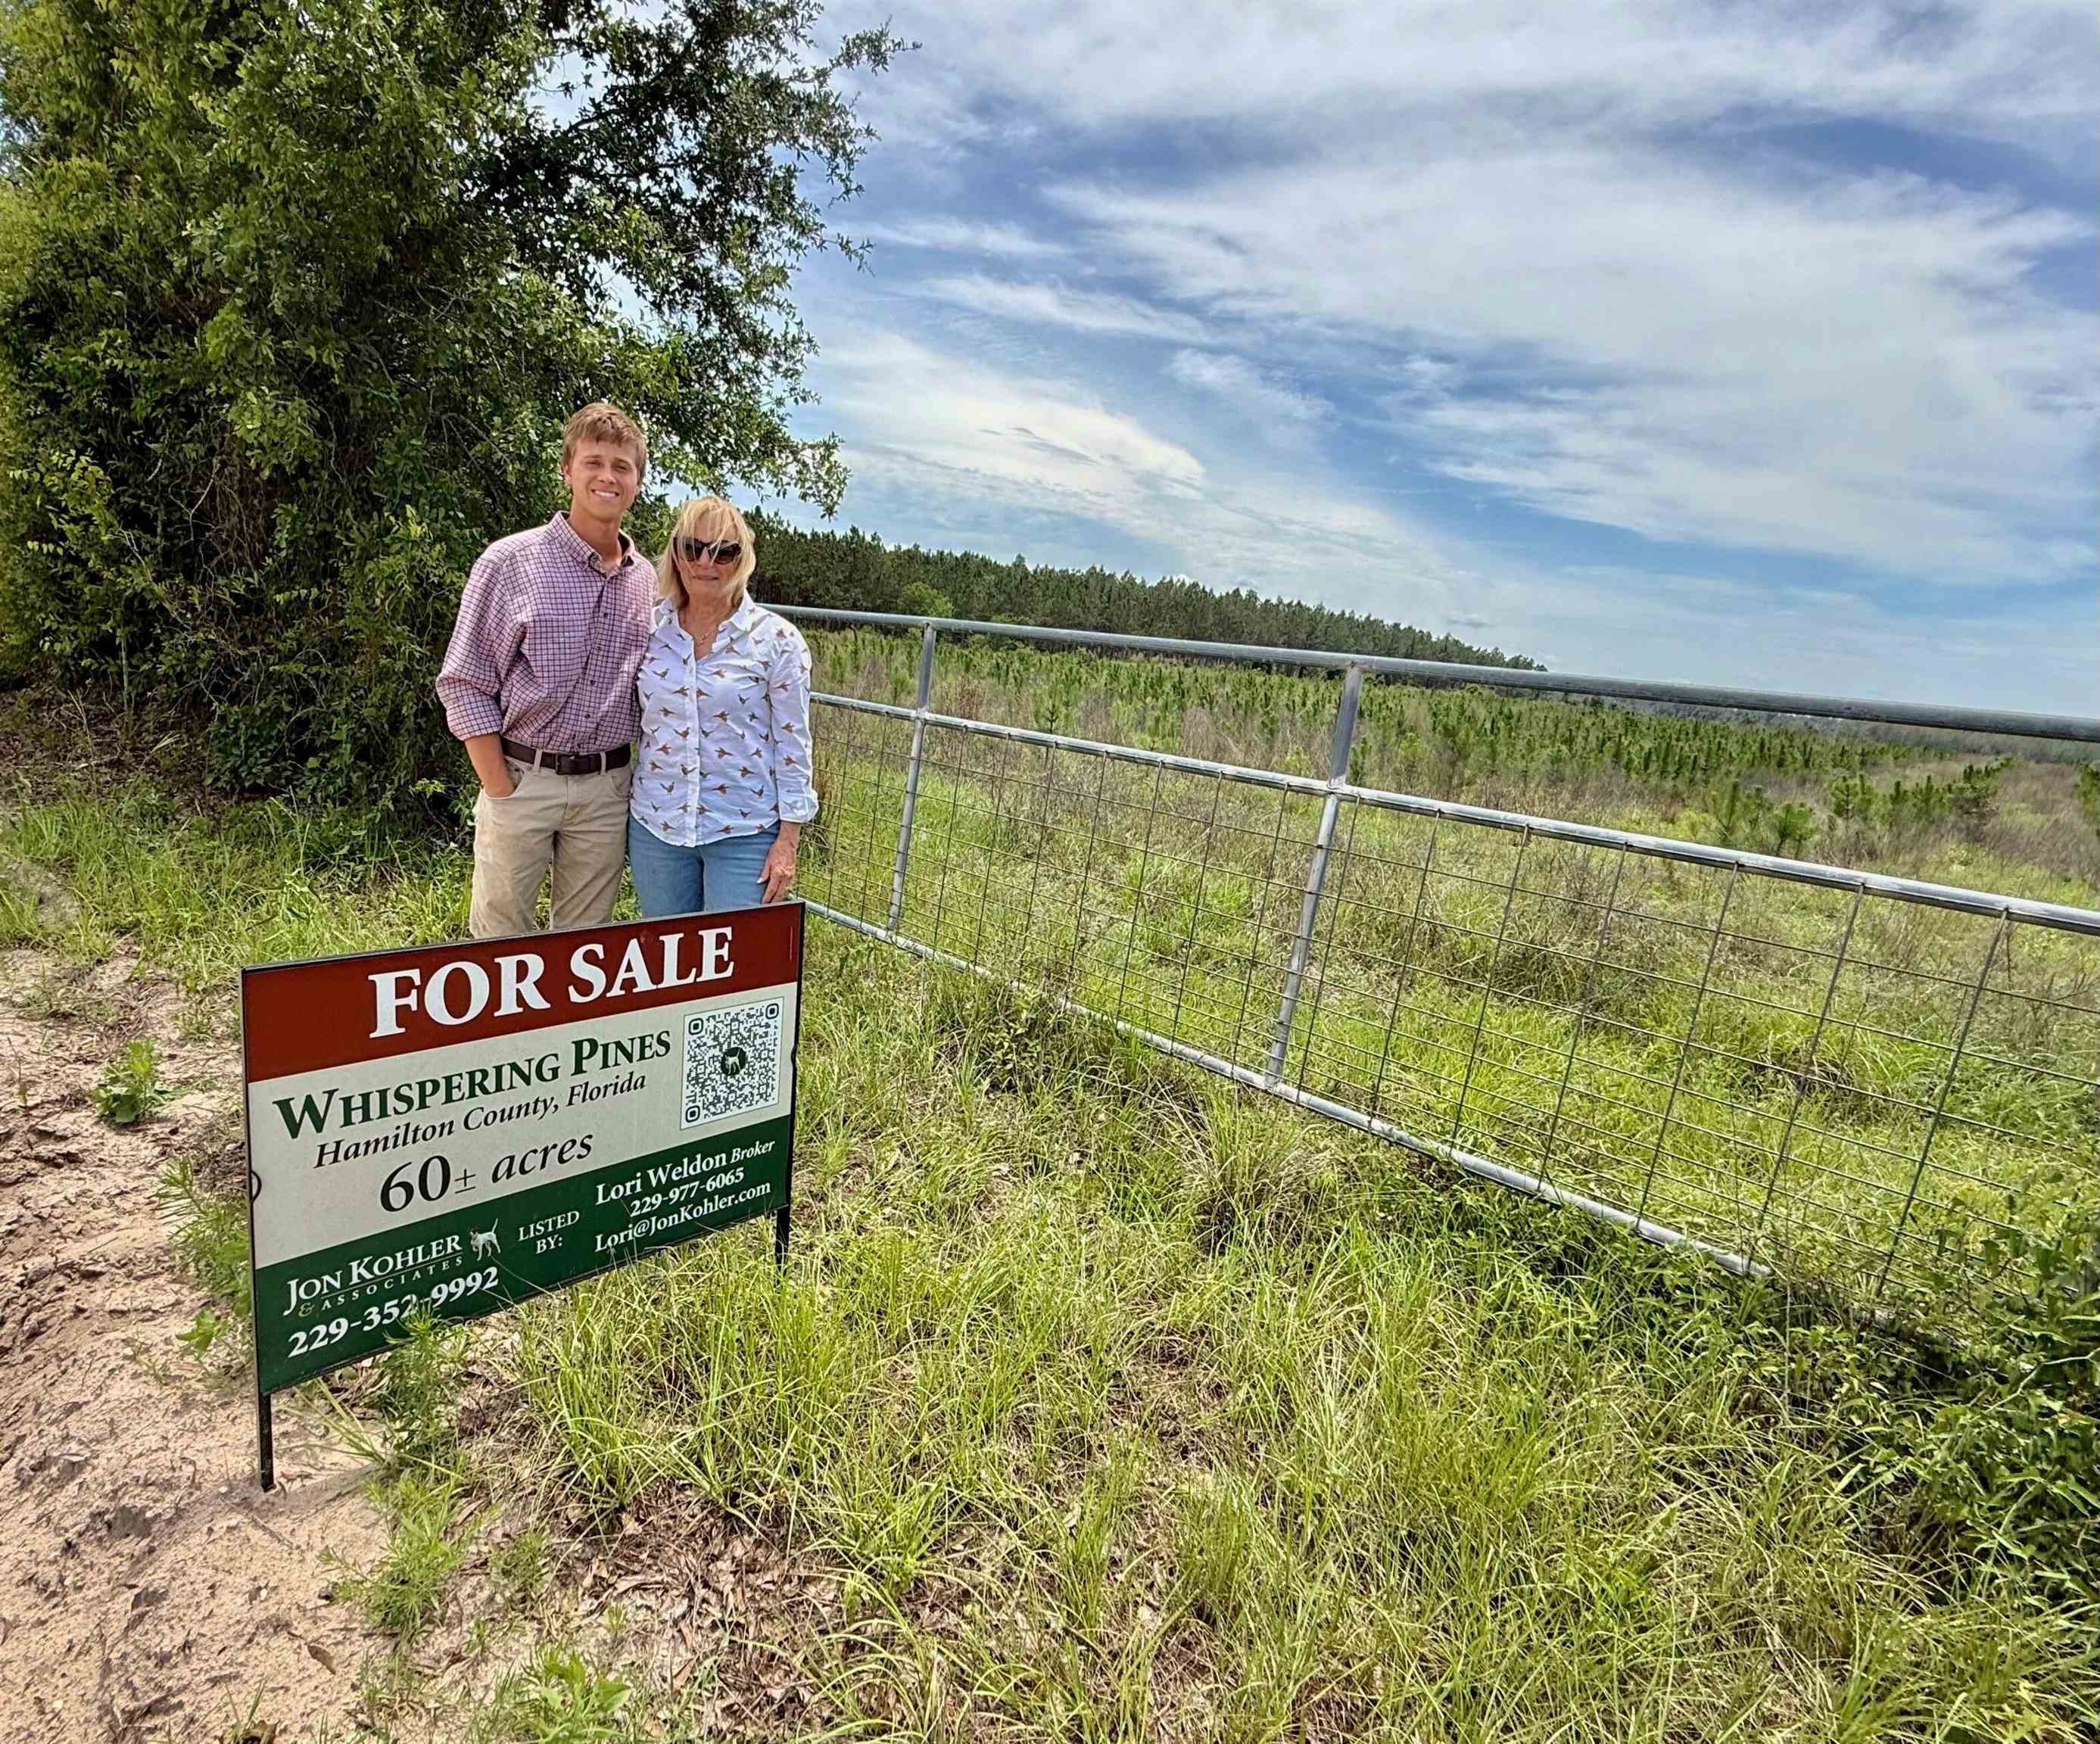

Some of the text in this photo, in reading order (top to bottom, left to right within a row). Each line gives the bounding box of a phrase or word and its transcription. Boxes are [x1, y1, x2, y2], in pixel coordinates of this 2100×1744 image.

[368, 926, 734, 1039] FOR SALE
[273, 1030, 671, 1139] WHISPERING PINES
[313, 1072, 646, 1169] Hamilton County, Florida
[491, 1135, 594, 1184] acres
[595, 1139, 775, 1205] Lori Weldon Broker
[629, 1167, 746, 1217] 229-977-6065
[519, 1210, 580, 1241] LISTED
[535, 1236, 563, 1254] BY:
[594, 1182, 771, 1253] Lori@JonKohler.com
[283, 1235, 463, 1316] JON KOHLER
[298, 1257, 463, 1318] & ASSOCIATES
[287, 1266, 500, 1359] 229-352-9992
